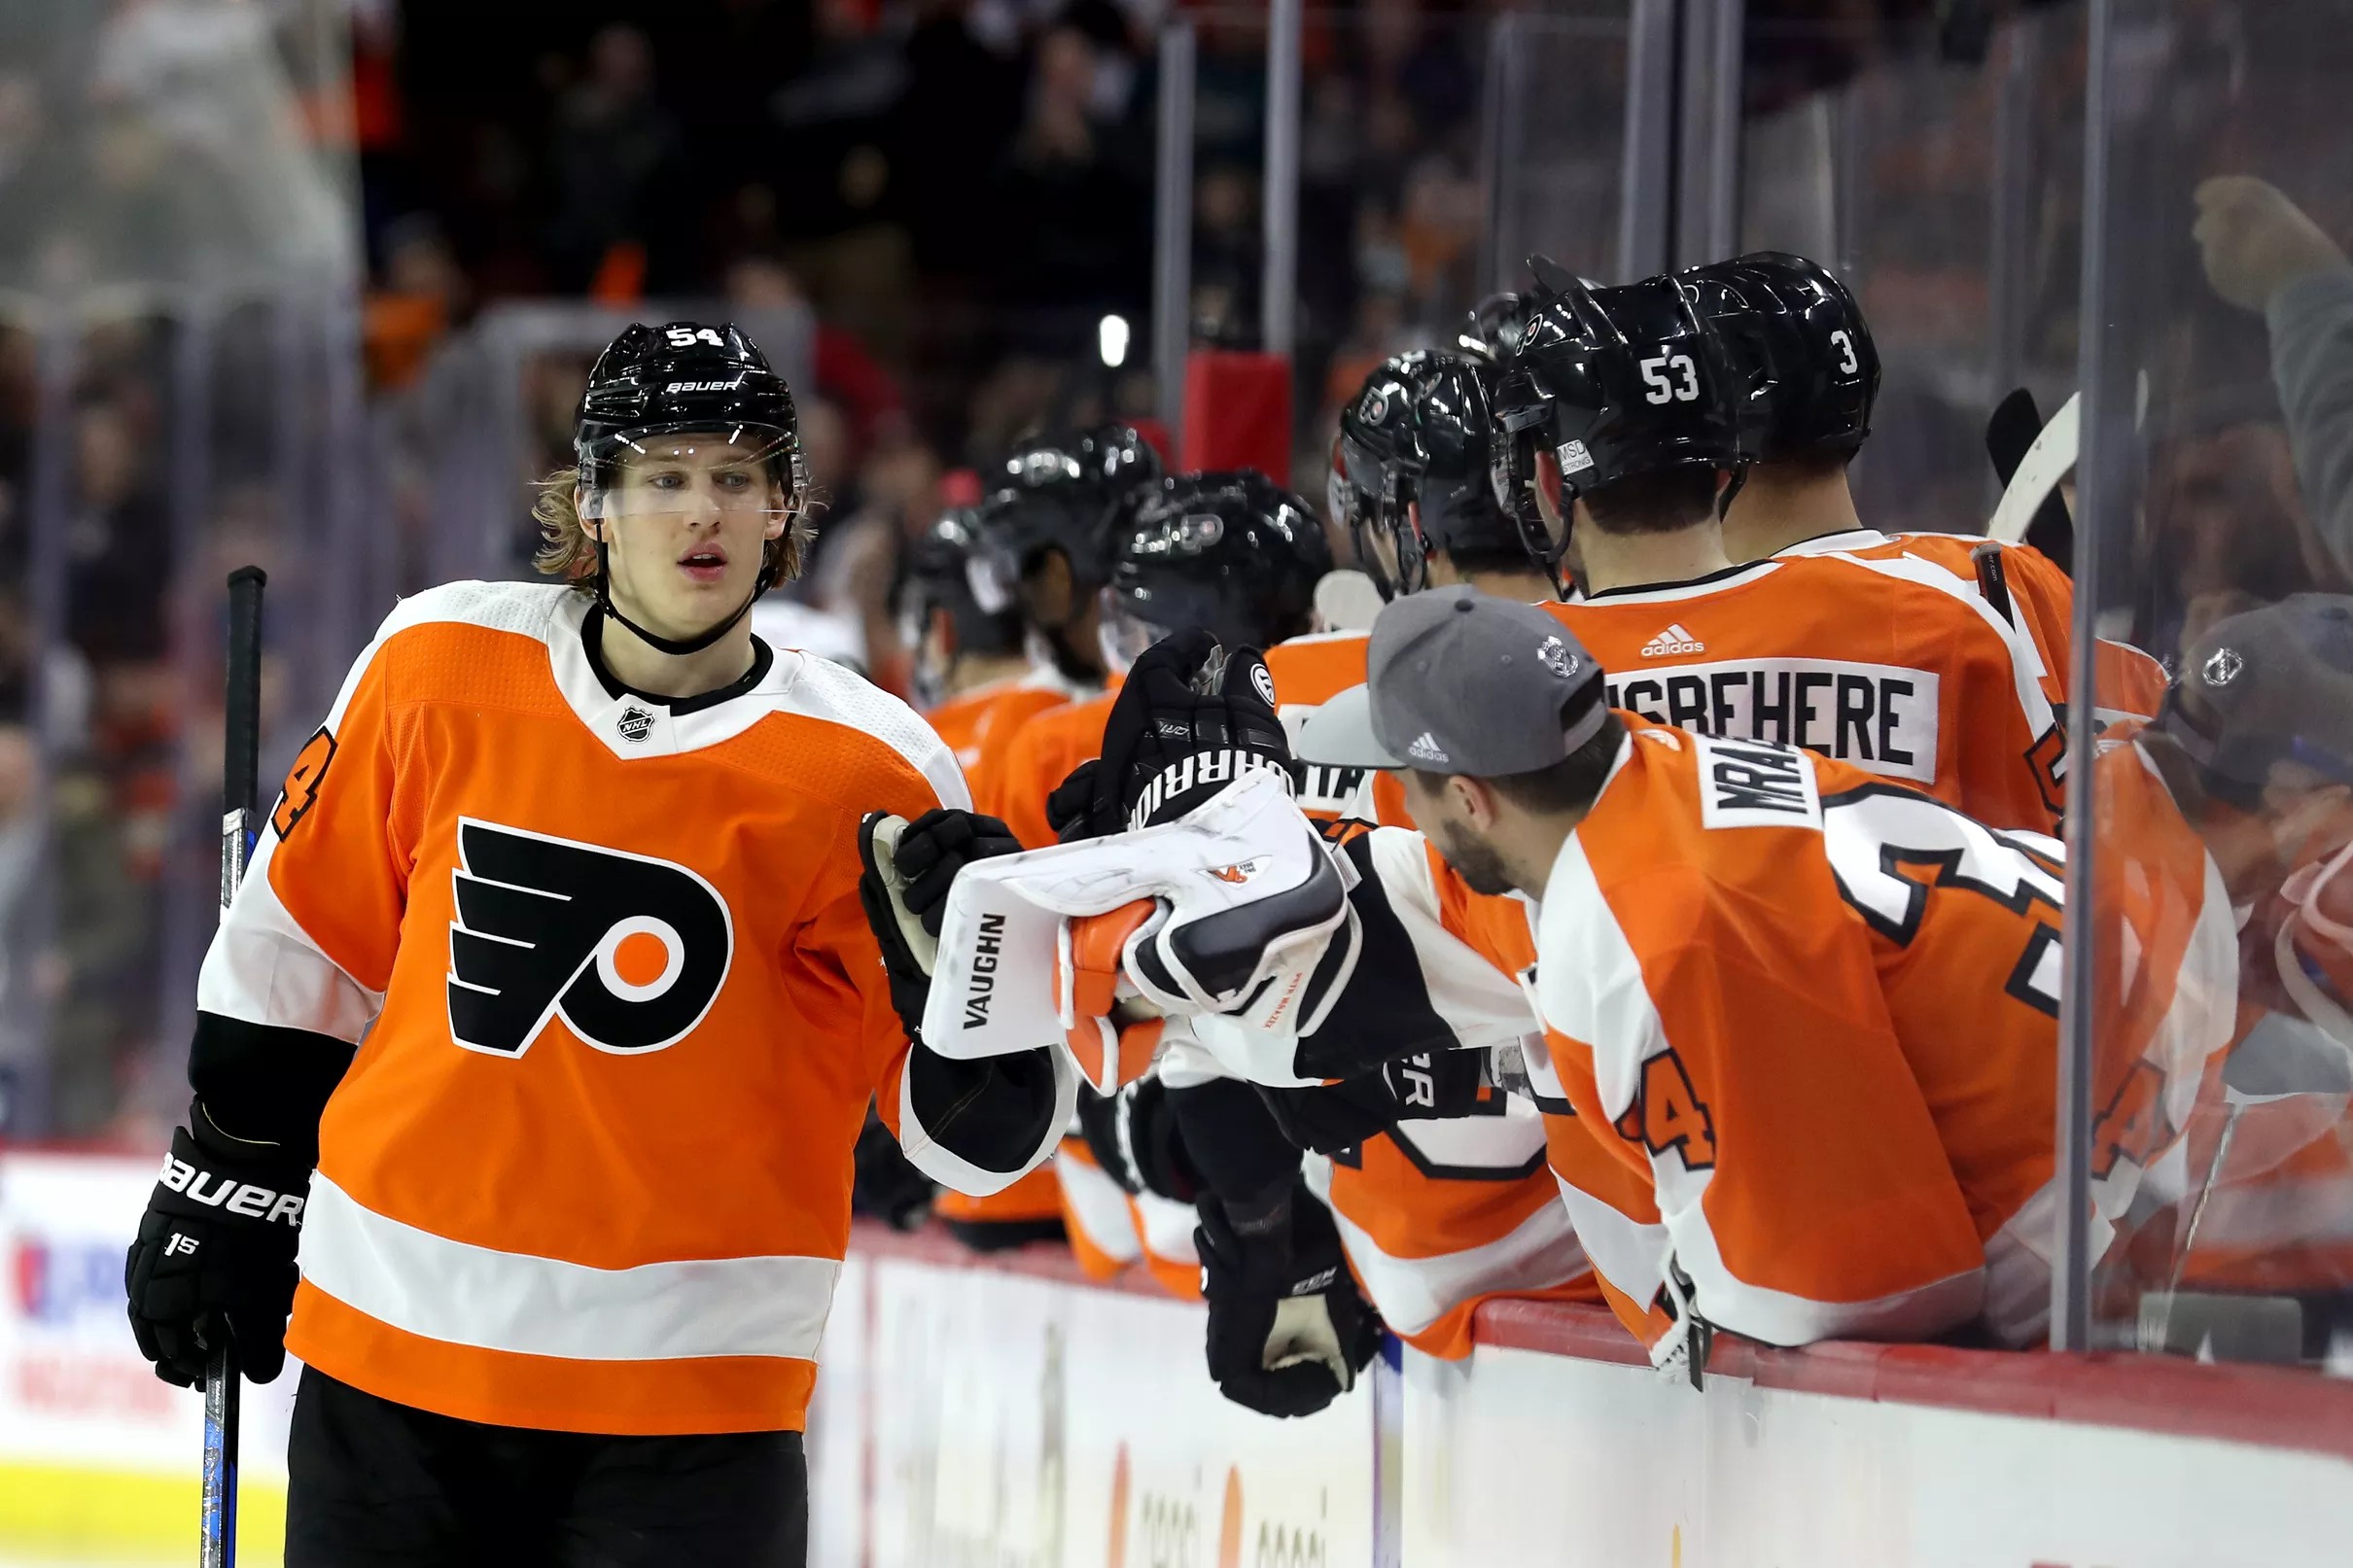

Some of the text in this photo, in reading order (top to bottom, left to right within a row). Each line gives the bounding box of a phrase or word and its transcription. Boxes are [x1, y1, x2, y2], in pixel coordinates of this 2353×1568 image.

[666, 328, 724, 347] 54
[1830, 331, 1858, 374] 3
[666, 380, 739, 393] BAUER
[1639, 355, 1700, 404] 53
[1557, 440, 1587, 460] MSD
[1563, 456, 1592, 472] STRONG
[1640, 641, 1705, 657] adidas
[623, 719, 649, 732] NHL
[1409, 746, 1450, 763] adidas
[1709, 733, 1809, 815] MRA
[963, 913, 1006, 1030] VAUGHN
[158, 1151, 305, 1227] BAUER
